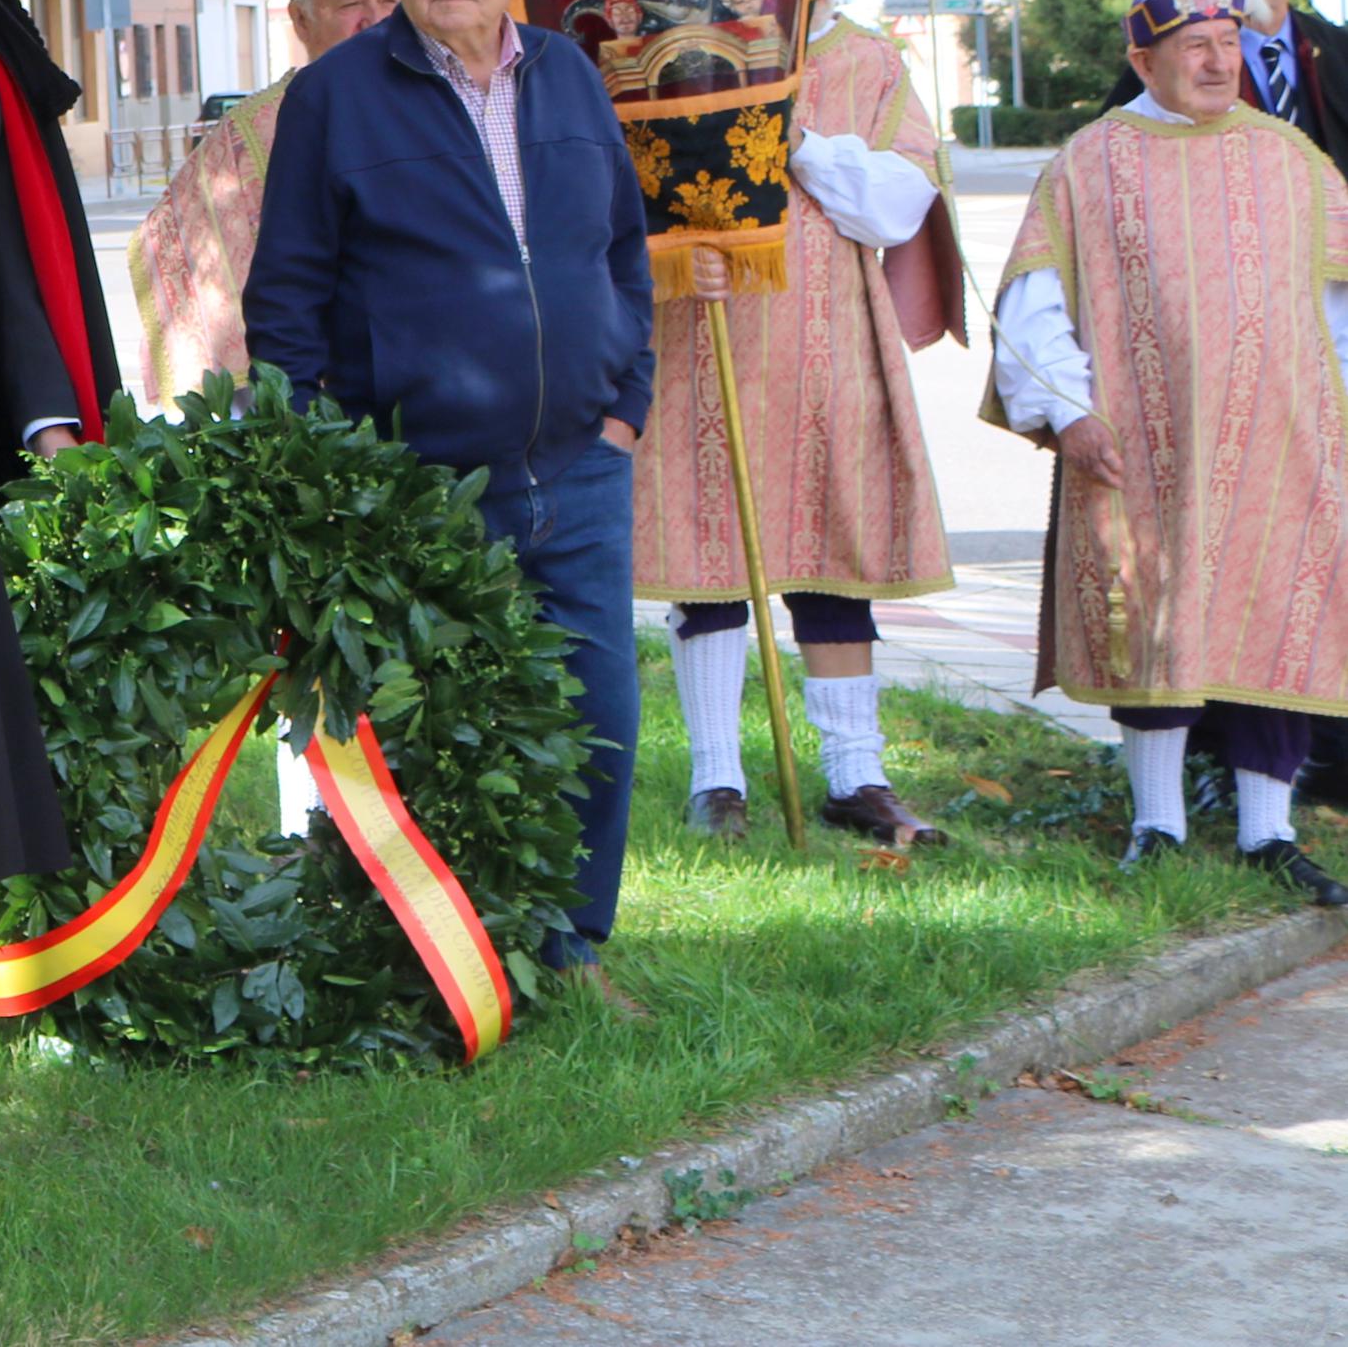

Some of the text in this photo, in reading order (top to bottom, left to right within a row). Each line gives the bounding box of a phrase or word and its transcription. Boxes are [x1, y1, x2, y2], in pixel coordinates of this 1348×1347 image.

[343, 745, 495, 1008] COOPERATIVA DEL CAMPO
